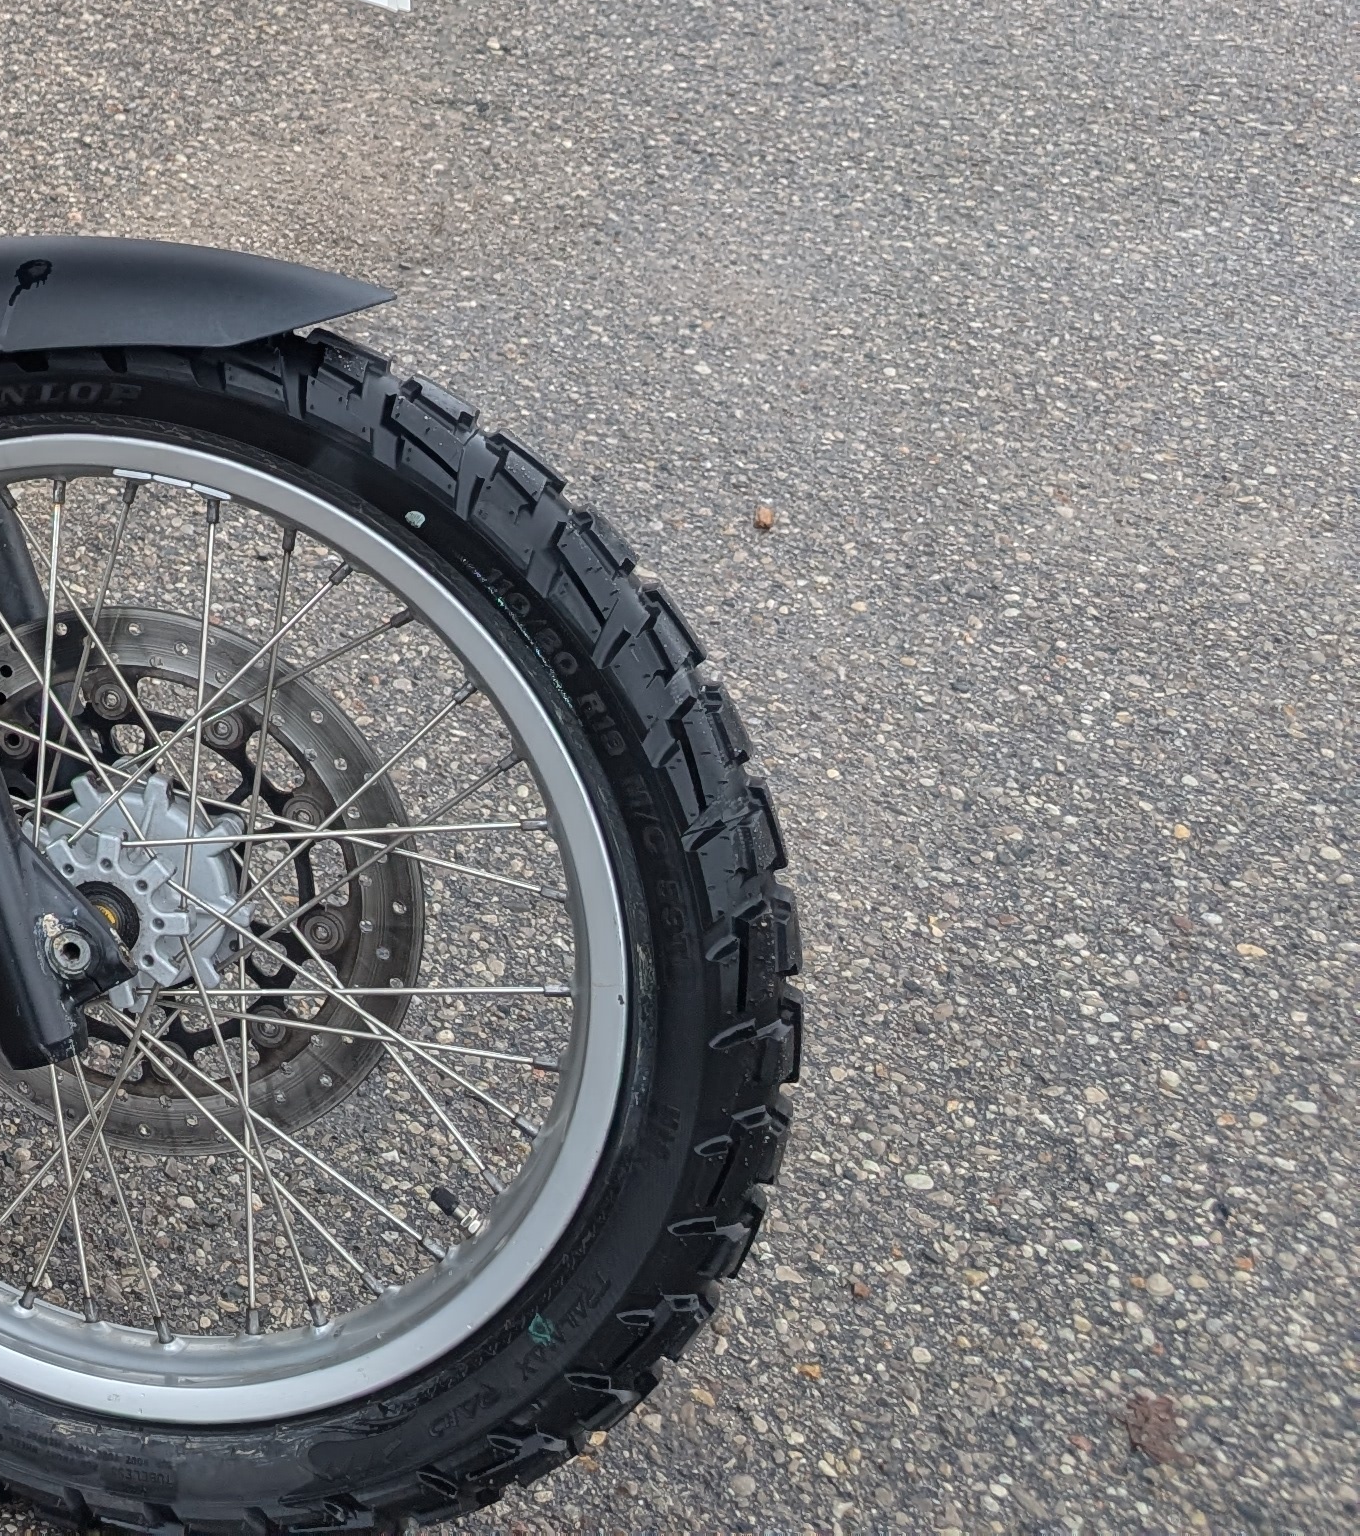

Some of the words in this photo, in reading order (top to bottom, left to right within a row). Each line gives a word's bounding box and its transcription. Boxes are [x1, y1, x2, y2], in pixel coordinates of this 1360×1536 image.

[484, 567, 580, 677] 110/80
[576, 690, 627, 757] R19
[429, 1384, 503, 1438] RAID
